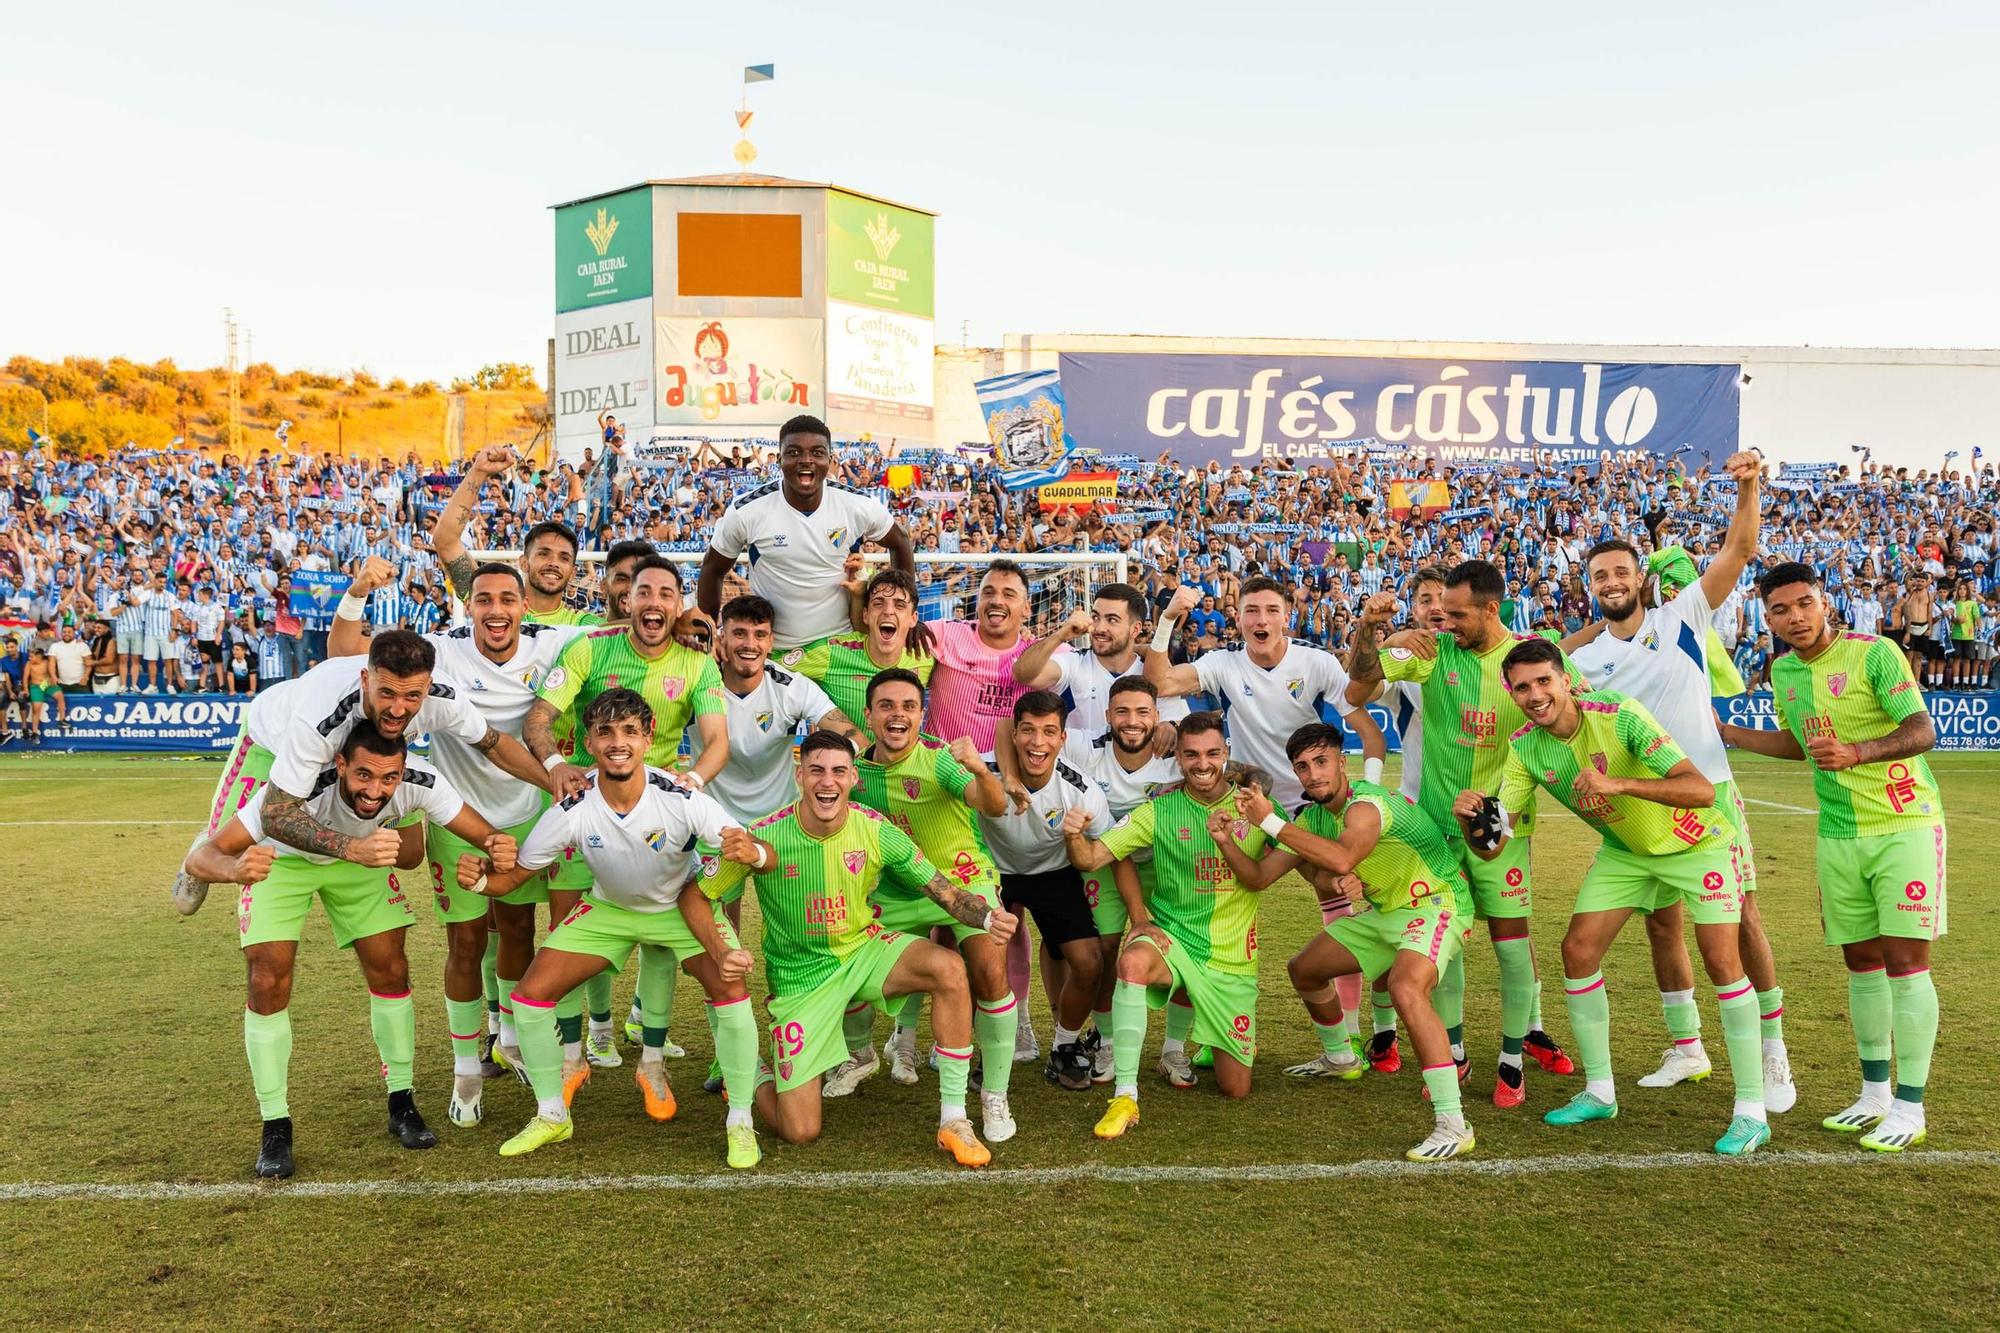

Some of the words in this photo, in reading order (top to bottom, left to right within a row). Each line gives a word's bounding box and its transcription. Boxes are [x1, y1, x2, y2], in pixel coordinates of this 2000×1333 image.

[577, 262, 598, 277] CAJA
[598, 256, 628, 272] RURAL
[565, 321, 641, 357] IDEAL
[559, 382, 637, 416] IDEAL
[1146, 368, 1358, 458] cafés
[1262, 442, 1283, 458] EL
[1043, 486, 1114, 498] GUADALMAR
[1145, 511, 1165, 521] SUR
[1444, 507, 1480, 518] MALAGA
[295, 570, 319, 582] ZONA
[323, 574, 348, 584] SOHO
[1931, 698, 1989, 716] IDAD
[44, 728, 61, 738] en
[64, 726, 116, 738] Linares
[119, 726, 156, 738] tiene
[1940, 736, 1959, 746] 653
[1961, 736, 1973, 746] 78
[1974, 736, 1988, 746] 06
[1888, 763, 1917, 804] Olin
[1195, 865, 1233, 884] laga
[812, 889, 847, 911] má
[1699, 891, 1732, 903] trafilex
[806, 907, 847, 926] laga
[1896, 903, 1932, 913] trafilex
[772, 1021, 805, 1060] 19
